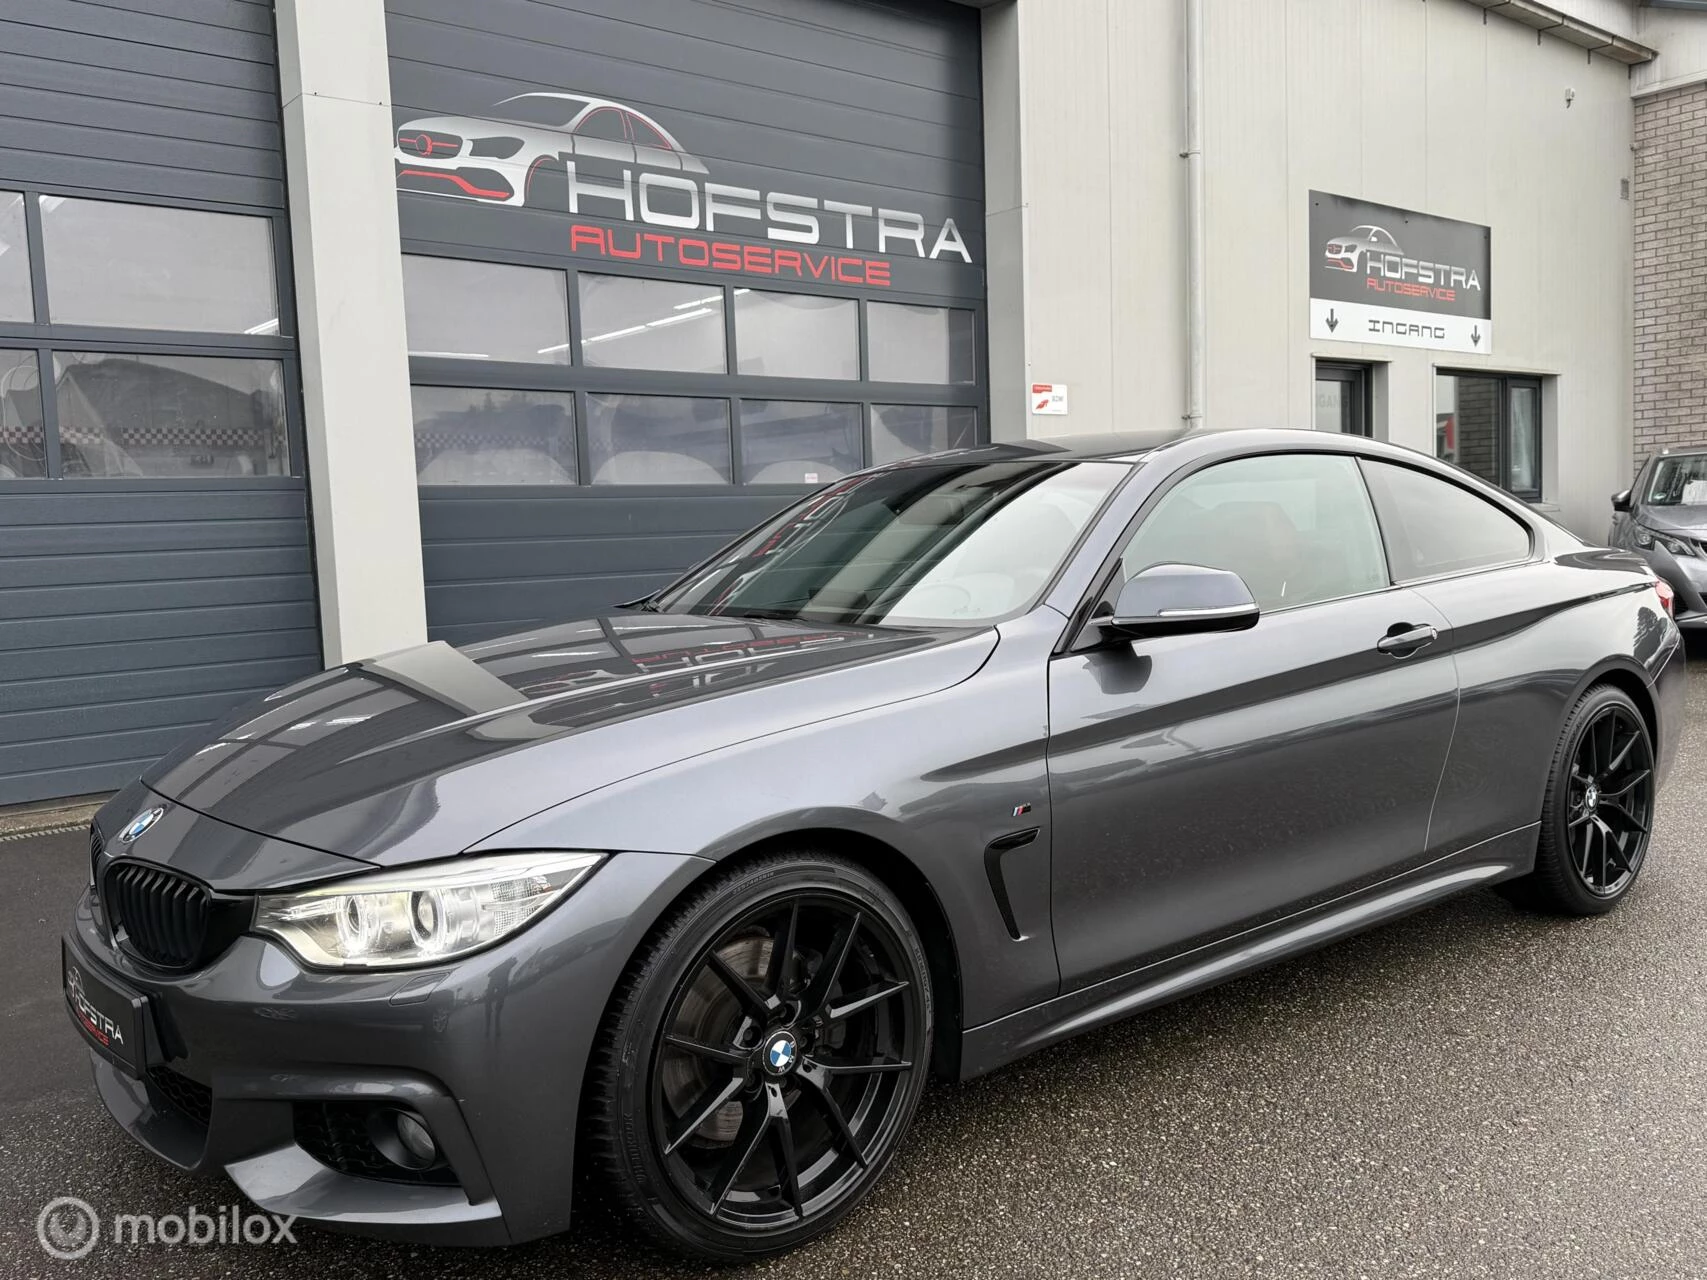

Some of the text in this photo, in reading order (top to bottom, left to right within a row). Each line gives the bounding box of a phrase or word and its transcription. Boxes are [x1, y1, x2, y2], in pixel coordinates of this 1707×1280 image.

[566, 160, 973, 263] HOFSTRA
[571, 225, 891, 286] AUTOSERVICE
[1366, 252, 1481, 290] HOFSTRA
[1366, 278, 1456, 301] AUTOSERVICE
[1368, 319, 1445, 339] INGANG
